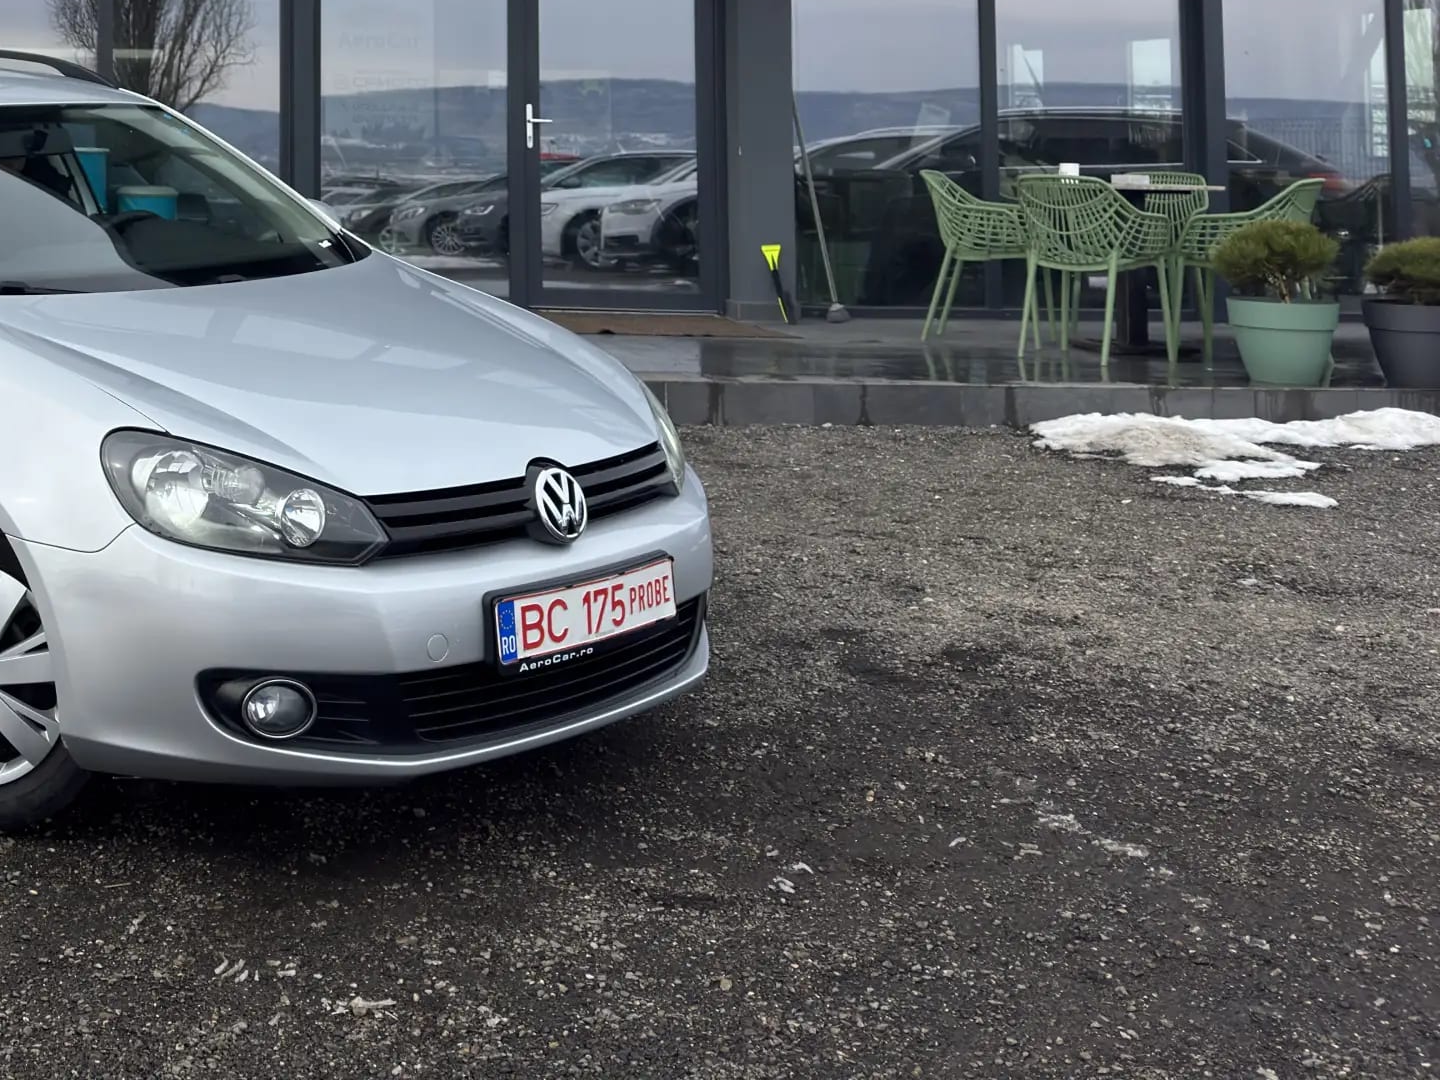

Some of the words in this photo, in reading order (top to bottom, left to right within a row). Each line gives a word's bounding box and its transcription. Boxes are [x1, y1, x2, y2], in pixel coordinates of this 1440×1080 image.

[501, 634, 517, 655] RO
[520, 598, 569, 651] BC
[582, 583, 626, 635] 175
[629, 575, 671, 615] PROBE
[519, 645, 594, 673] AeroCar.ro
